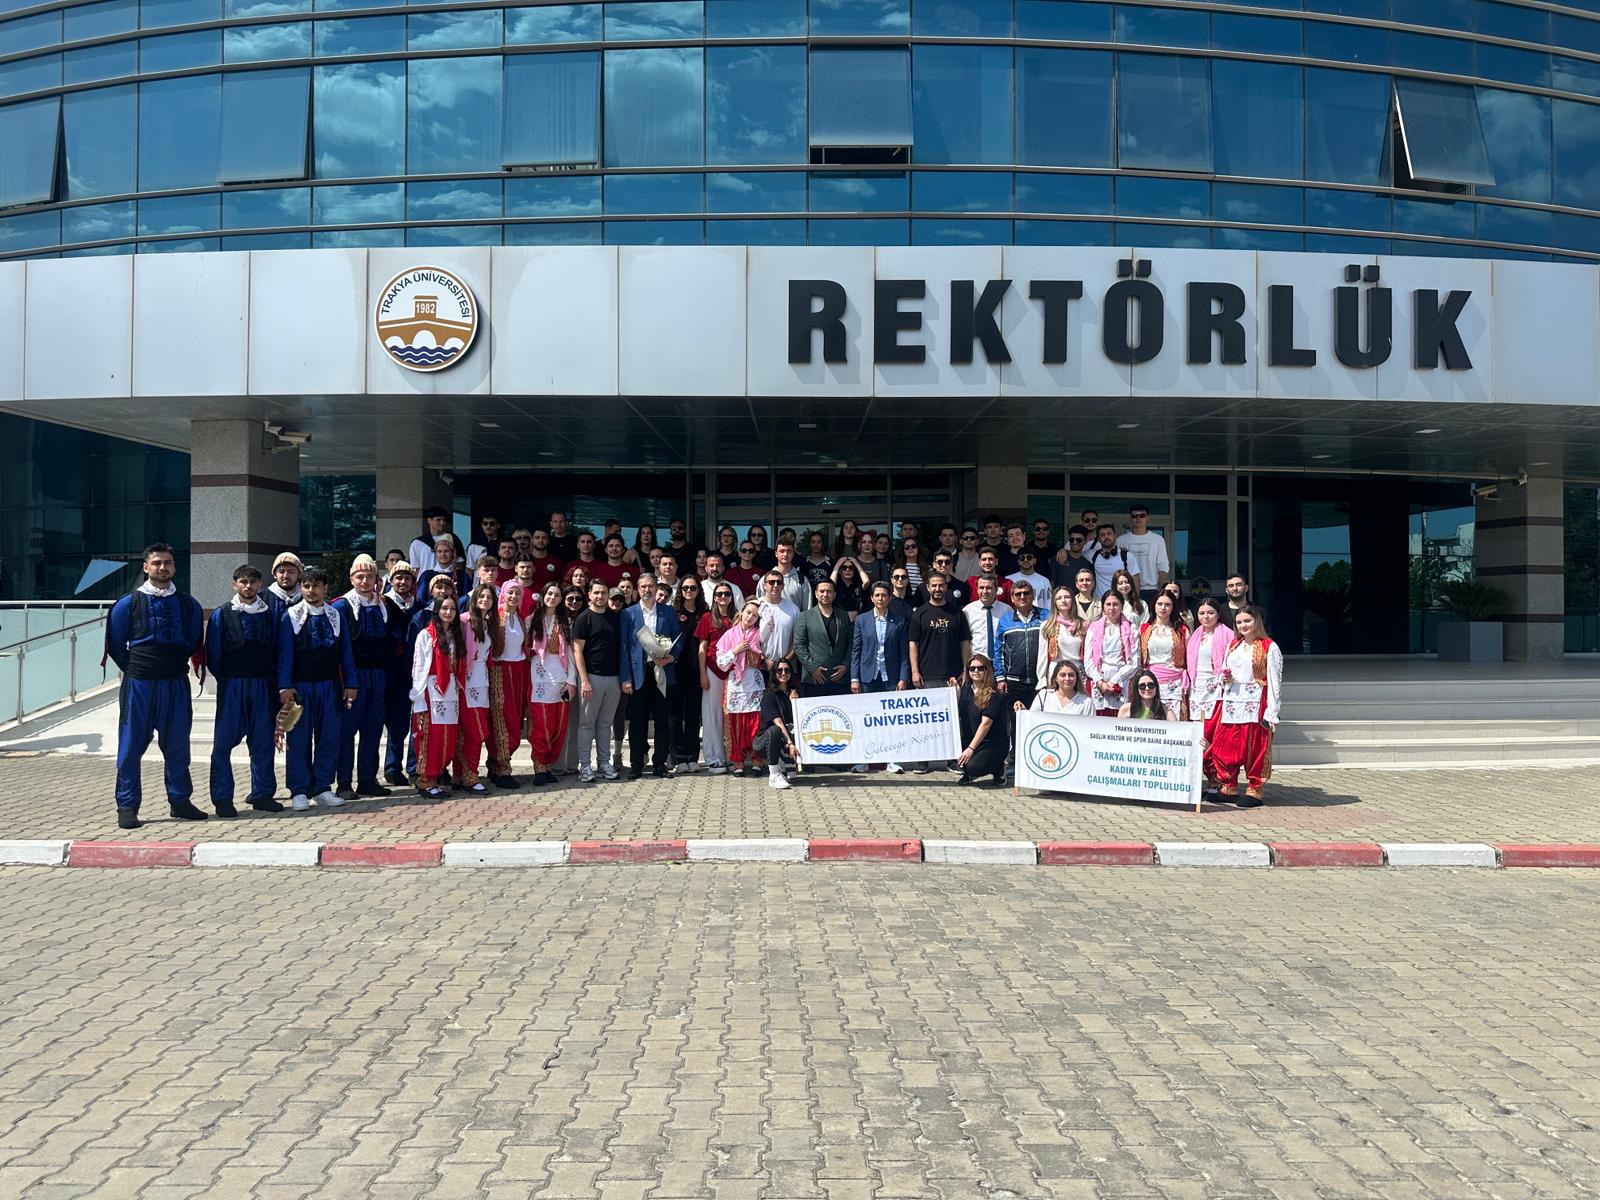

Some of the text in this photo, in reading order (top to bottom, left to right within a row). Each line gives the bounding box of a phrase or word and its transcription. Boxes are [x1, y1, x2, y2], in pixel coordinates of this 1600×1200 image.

[381, 270, 472, 319] TRAKYA ÜNİVERSİTESİ
[415, 303, 436, 314] 1982
[788, 259, 1472, 371] REKTÖRLÜK
[880, 696, 930, 710] TRAKYA
[863, 708, 950, 728] ÜNİVERSİTESİ
[1115, 725, 1167, 735] TRAKYA ÜNİVERSİTESİ
[1090, 732, 1107, 740] SAĞLIK
[1107, 733, 1125, 741] KÜLTÜR
[1133, 736, 1147, 744] SPOR
[1148, 737, 1162, 745] DAİRE
[1163, 738, 1193, 748] BAŞKANLIĞI
[1093, 751, 1187, 767] TRAKYA ÜNİVERSİTESİ
[1109, 764, 1168, 778] KADIN VE AİLE
[1087, 774, 1191, 793] ÇALIŞMALARI TOPLULUĞU
